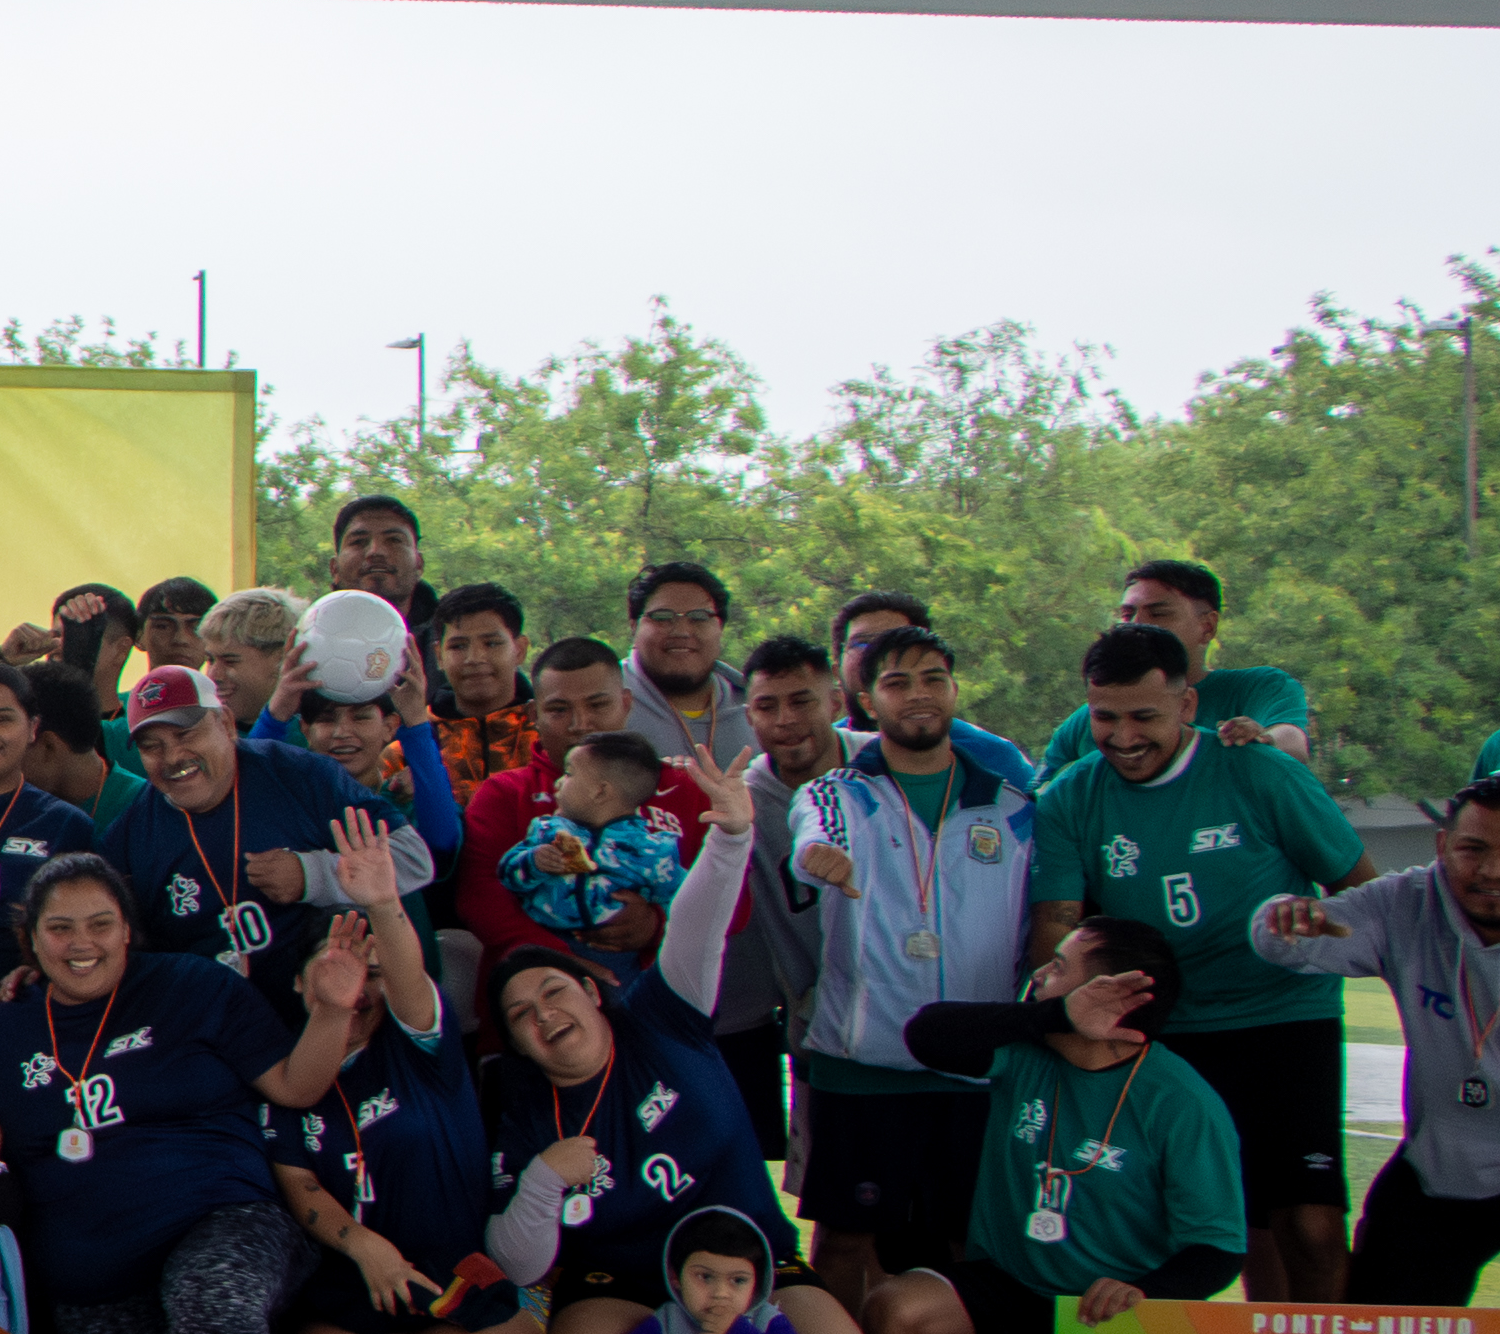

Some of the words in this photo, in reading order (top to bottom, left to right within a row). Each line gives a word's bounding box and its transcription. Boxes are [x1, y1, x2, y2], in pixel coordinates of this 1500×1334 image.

[1, 836, 48, 857] SIX
[1188, 822, 1241, 855] SIX
[1162, 872, 1201, 928] 5
[103, 1025, 153, 1058] SIX
[636, 1080, 680, 1133] SIX
[641, 1153, 695, 1203] 2
[1253, 1314, 1345, 1334] PONTE
